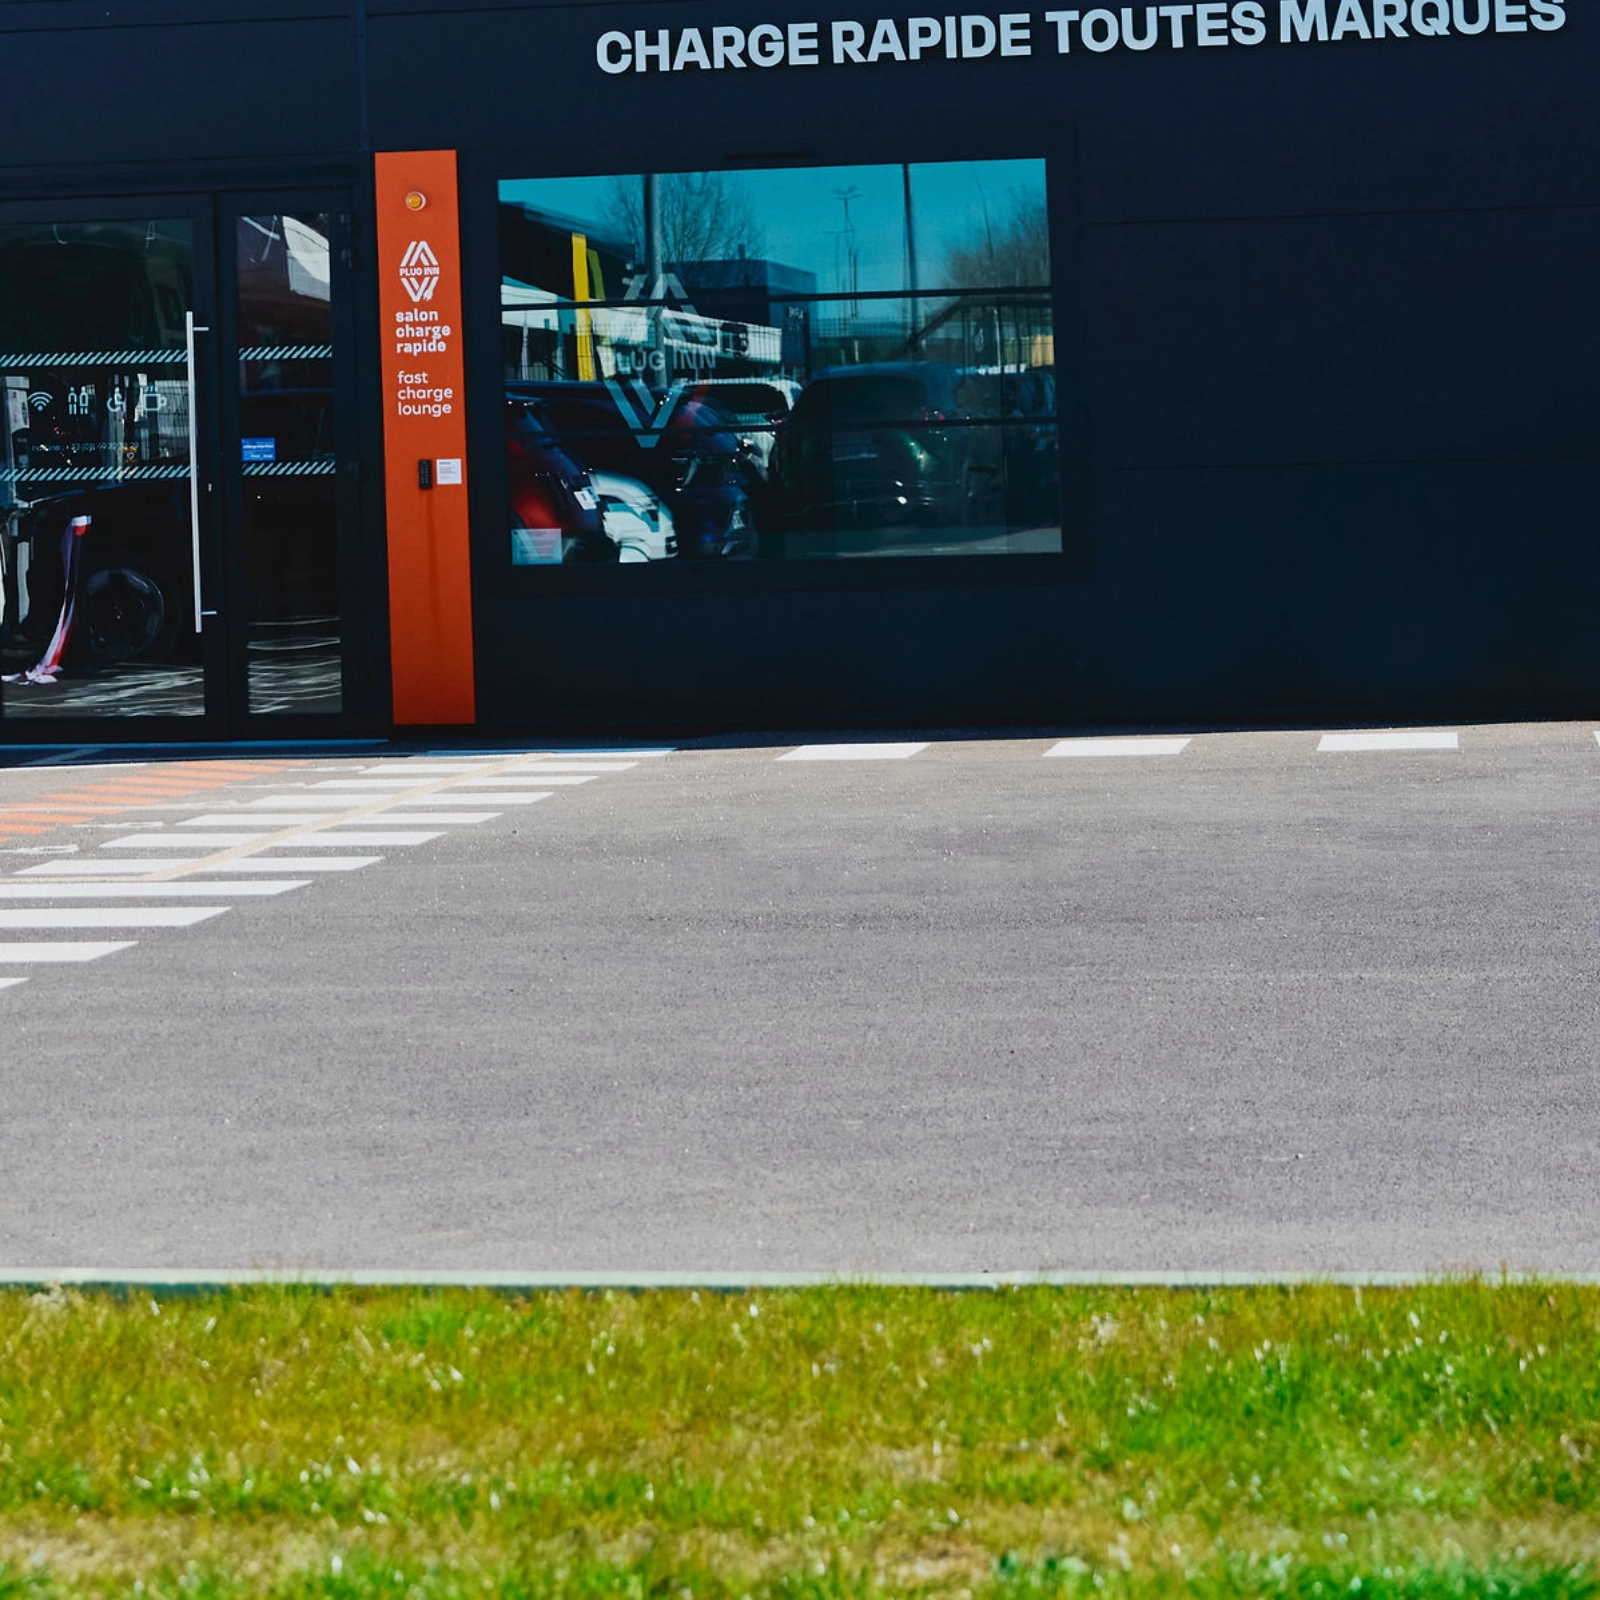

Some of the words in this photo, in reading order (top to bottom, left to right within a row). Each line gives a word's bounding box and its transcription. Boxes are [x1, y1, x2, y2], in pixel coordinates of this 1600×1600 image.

[596, 22, 819, 75] CHARGE
[832, 12, 1032, 65] RAPIDE
[1045, 0, 1266, 54] TOUTES
[400, 267, 422, 276] PLUG
[424, 266, 440, 275] INN
[395, 308, 438, 322] salon
[395, 324, 451, 339] charge
[396, 339, 446, 356] rapide
[397, 371, 428, 384] fast
[397, 388, 453, 402] charge
[398, 402, 452, 417] lounge
